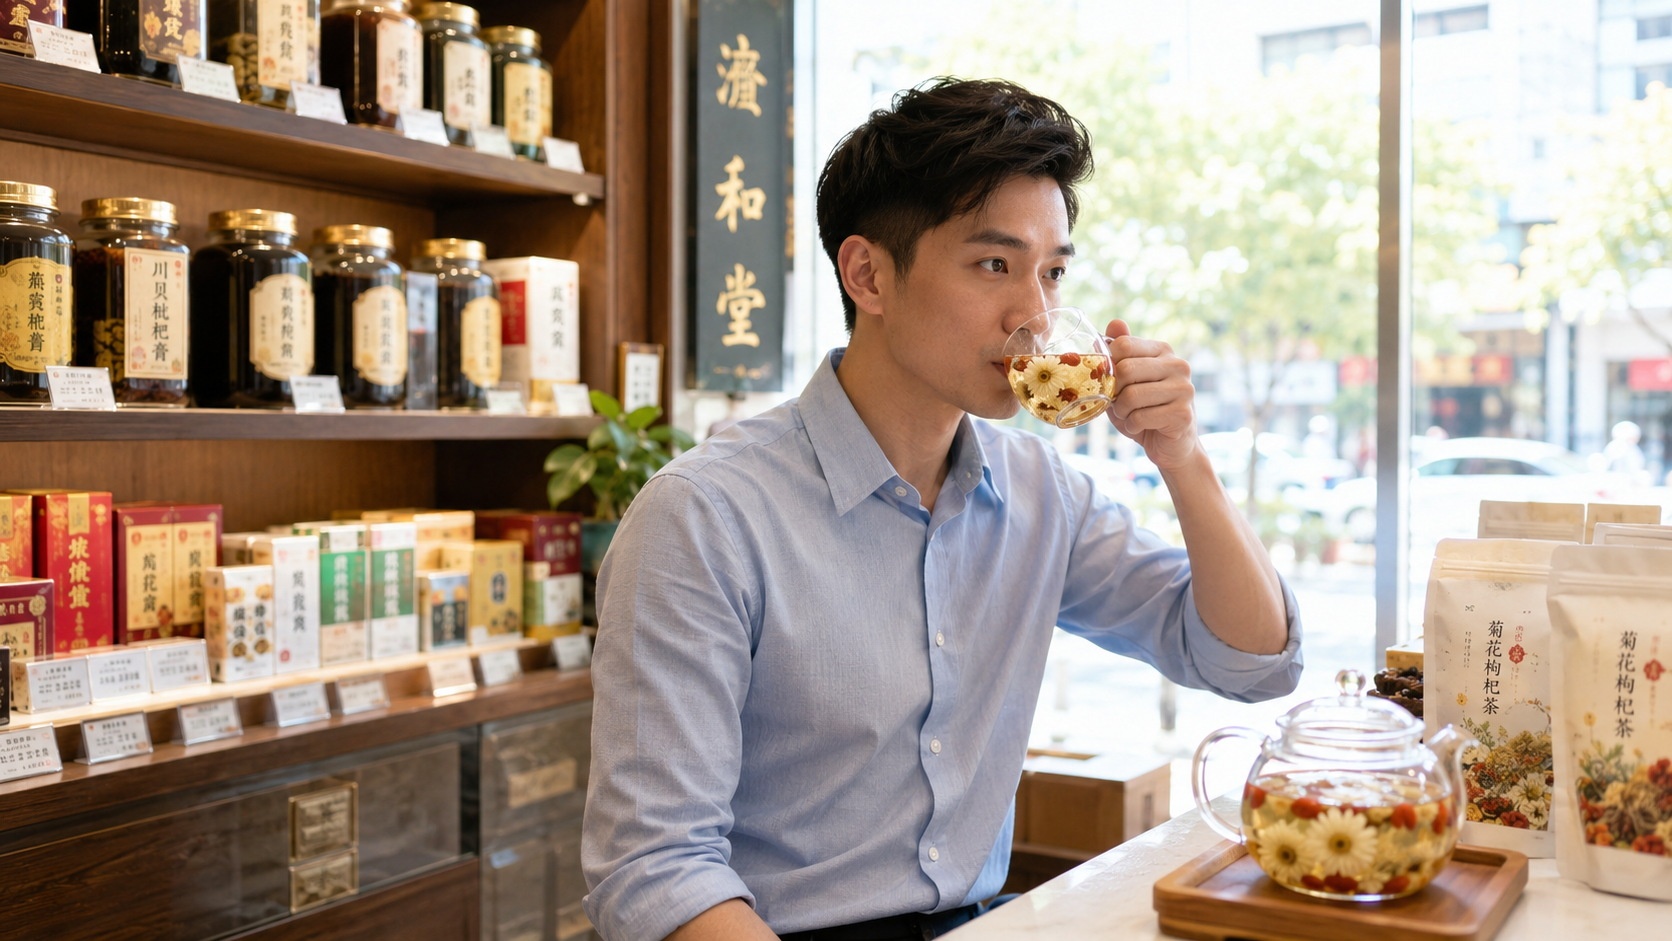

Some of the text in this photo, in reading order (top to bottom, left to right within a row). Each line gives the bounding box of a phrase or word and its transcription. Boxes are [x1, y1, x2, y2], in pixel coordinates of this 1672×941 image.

[152, 261, 170, 362] 川贝枇杷膏
[1482, 620, 1504, 715] 菊花枸杞茶
[1614, 630, 1638, 739] 菊花枸杞茶
